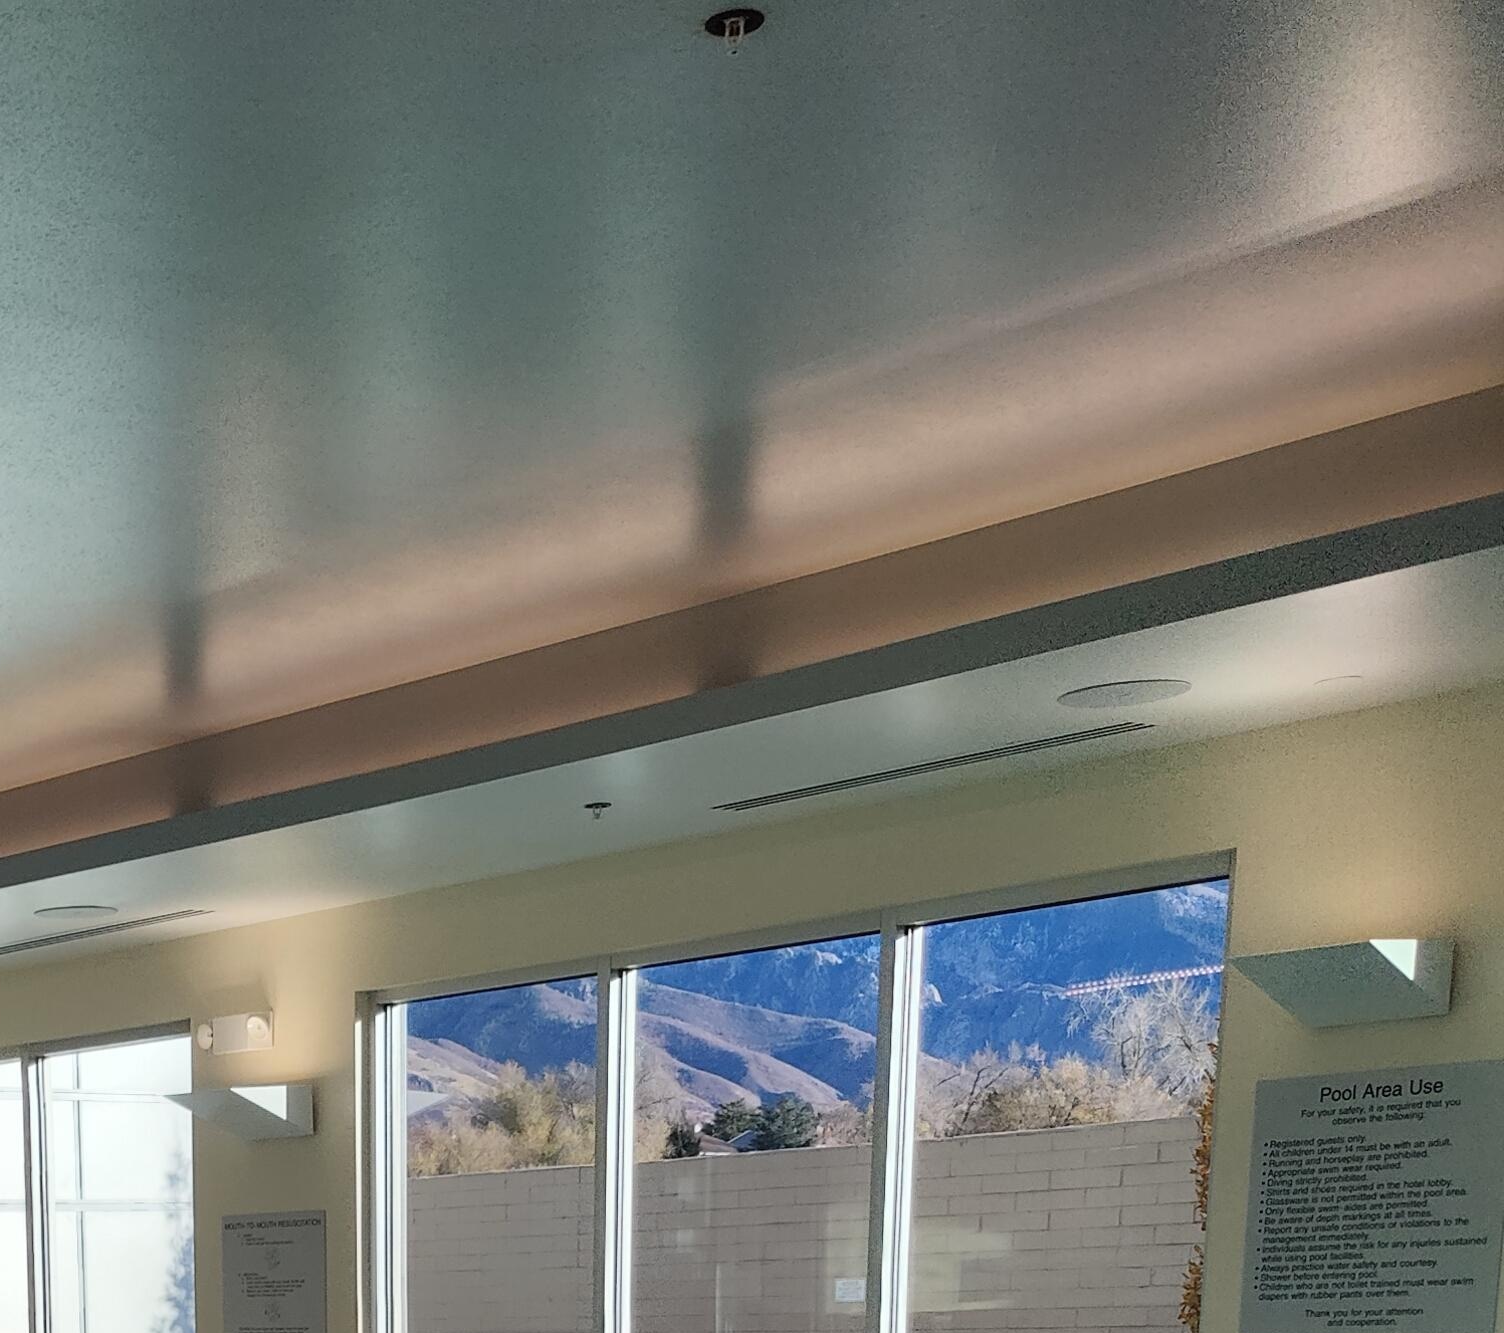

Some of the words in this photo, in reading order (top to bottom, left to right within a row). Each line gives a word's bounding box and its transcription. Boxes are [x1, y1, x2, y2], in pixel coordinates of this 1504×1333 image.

[1319, 1083, 1357, 1103] Pool
[1361, 1080, 1403, 1099] Area
[1409, 1076, 1444, 1095] Use
[1300, 1108, 1315, 1118] For
[1316, 1108, 1336, 1117] your
[1338, 1104, 1366, 1116] safety,
[1367, 1104, 1374, 1112] it
[1386, 1100, 1423, 1113] required
[1424, 1098, 1442, 1108] that
[1443, 1098, 1461, 1108] you
[1268, 1137, 1315, 1150] Registered
[1268, 1149, 1280, 1158] All
[1280, 1146, 1315, 1158] children
[1316, 1145, 1342, 1155] under
[1355, 1143, 1377, 1152] must
[1378, 1141, 1391, 1151] be
[1392, 1140, 1411, 1149] with
[1413, 1140, 1425, 1148] an
[1267, 1157, 1303, 1169] Running
[1304, 1156, 1321, 1165] and
[1322, 1153, 1364, 1165] horseplay
[1367, 1153, 1382, 1161] are
[1265, 1185, 1290, 1197] Shirts
[1291, 1185, 1309, 1195] and
[1310, 1183, 1336, 1194] shoes
[1338, 1182, 1374, 1194] required
[1385, 1181, 1400, 1189] the
[1402, 1179, 1425, 1188] hotel
[1266, 1176, 1293, 1188] Diving
[1294, 1175, 1322, 1186] strictly
[1320, 1194, 1334, 1203] not
[1379, 1190, 1404, 1199] within
[1406, 1189, 1421, 1198] the
[1423, 1188, 1443, 1198] pool
[1263, 1216, 1276, 1225] Be
[1277, 1216, 1303, 1224] aware
[1304, 1214, 1314, 1223] of
[1315, 1213, 1340, 1223] depth
[1341, 1211, 1381, 1223] markings
[1383, 1211, 1392, 1219] at
[1394, 1209, 1405, 1218] all
[1263, 1225, 1292, 1235] Report
[1293, 1225, 1308, 1234] any
[1310, 1222, 1340, 1232] unsafe
[1340, 1221, 1385, 1231] conditions
[1399, 1218, 1441, 1228] violations
[1443, 1217, 1452, 1226] to
[1454, 1216, 1469, 1226] the
[1260, 1263, 1290, 1274] Always
[1290, 1261, 1325, 1272] practice
[1326, 1261, 1350, 1270] water
[1351, 1260, 1378, 1270] safety
[1380, 1259, 1397, 1268] and
[1259, 1272, 1291, 1282] Shower
[1292, 1271, 1320, 1281] before
[1320, 1271, 1356, 1281] entering
[1259, 1281, 1294, 1291] Children
[1295, 1281, 1313, 1290] who
[1330, 1280, 1345, 1289] not
[1346, 1280, 1368, 1288] toilet
[1369, 1279, 1400, 1288] trained
[1402, 1278, 1424, 1287] must
[1426, 1278, 1448, 1286] wear
[1450, 1277, 1474, 1285] swim
[1257, 1292, 1288, 1302] diapers
[1290, 1291, 1308, 1299] with
[1309, 1290, 1338, 1299] rubber
[1339, 1290, 1362, 1300] pants
[1304, 1308, 1330, 1318] Thank
[1332, 1310, 1348, 1318] you
[1350, 1308, 1362, 1316] for
[1364, 1308, 1383, 1318] your
[1326, 1318, 1343, 1326] and
